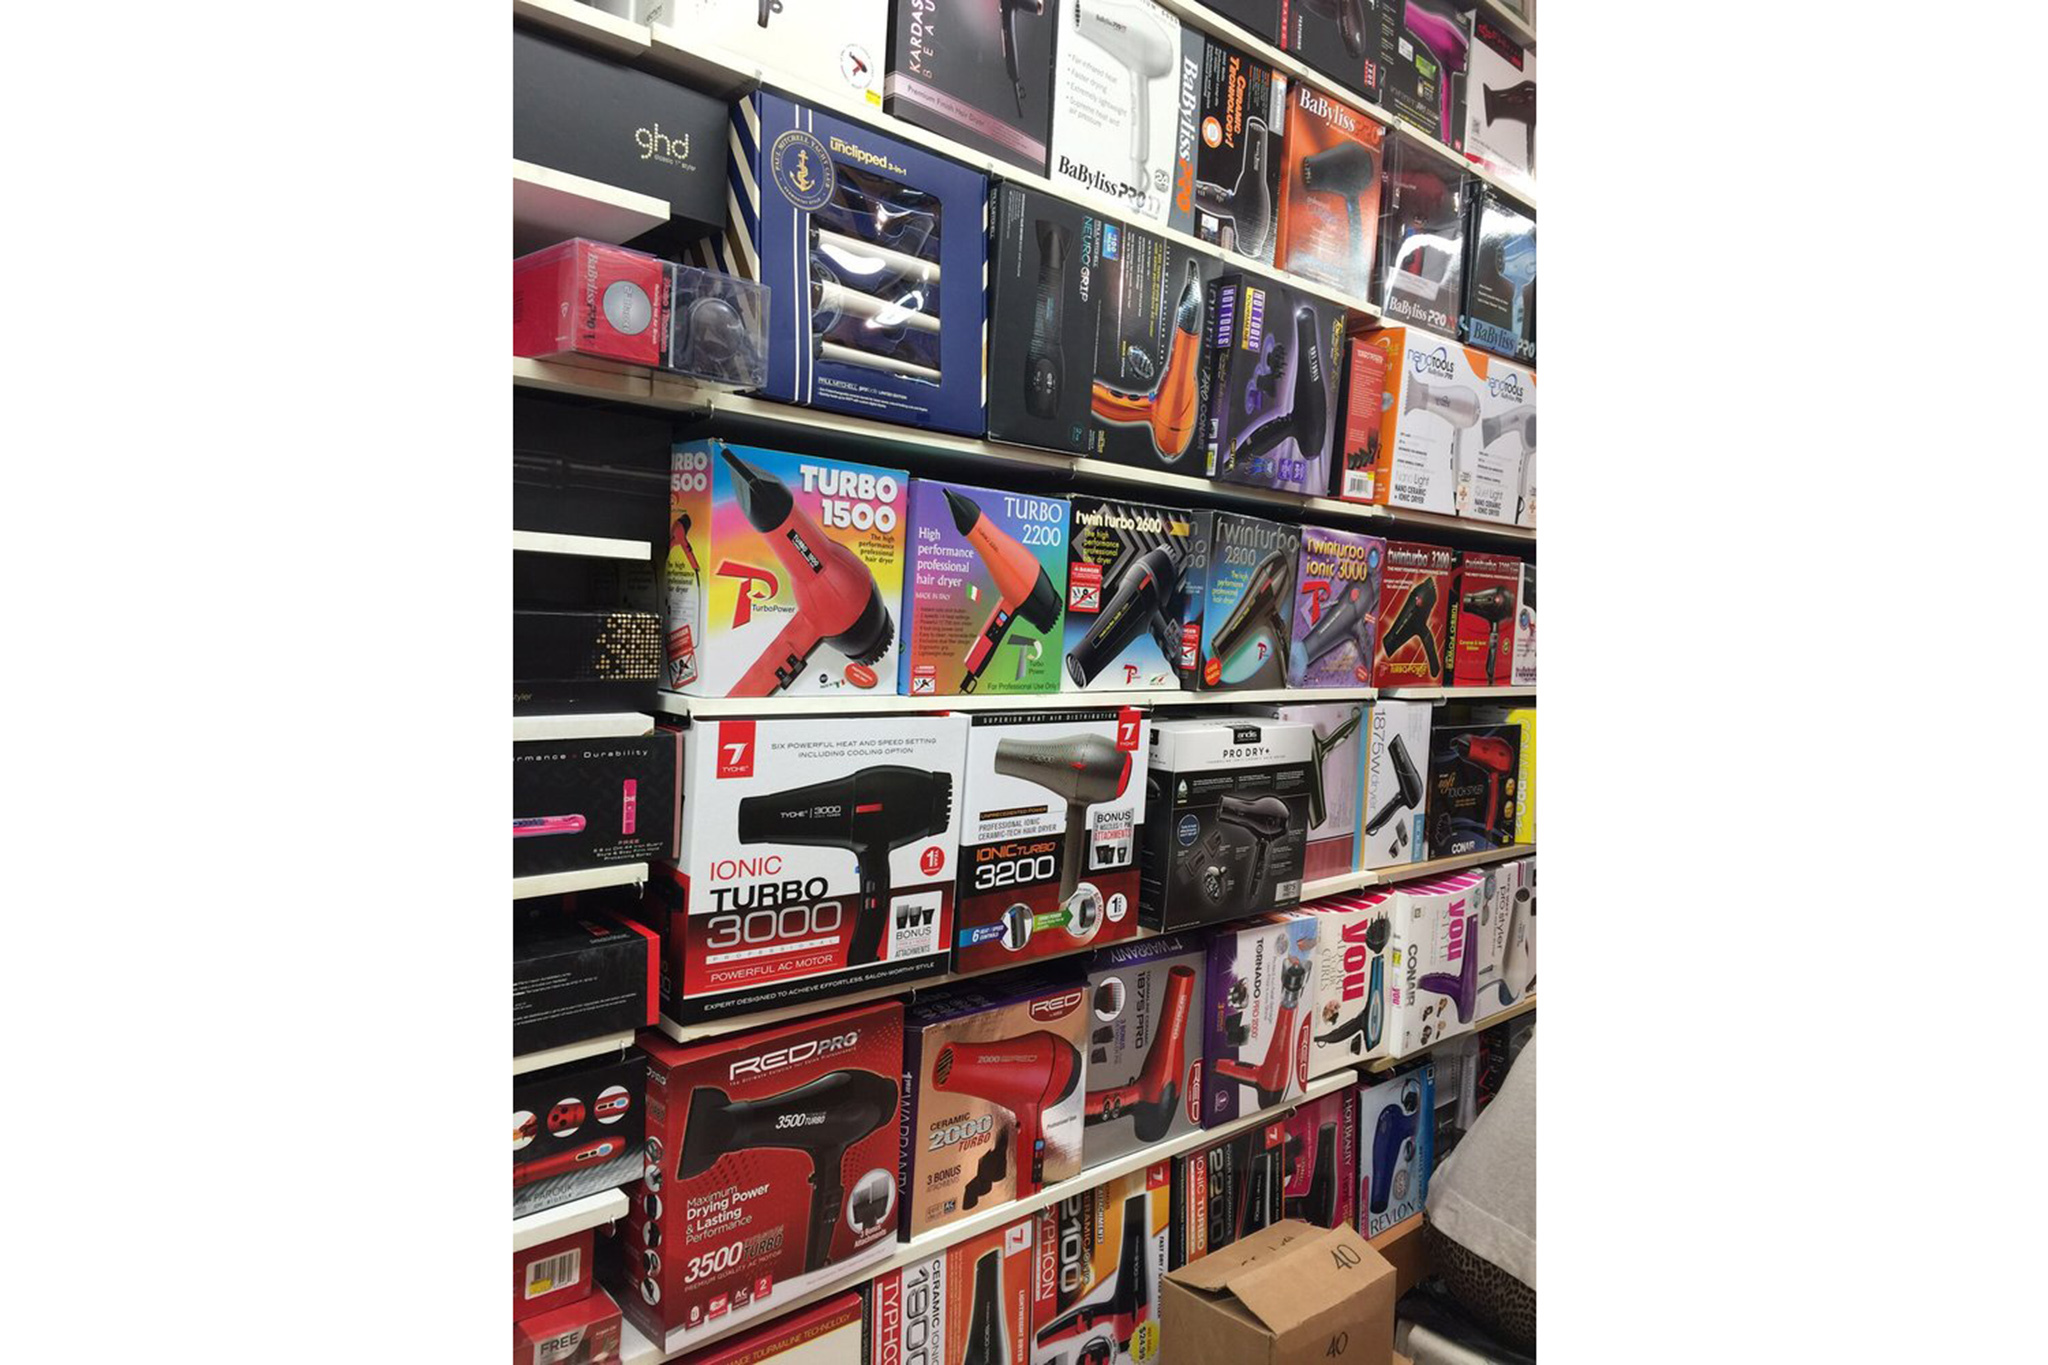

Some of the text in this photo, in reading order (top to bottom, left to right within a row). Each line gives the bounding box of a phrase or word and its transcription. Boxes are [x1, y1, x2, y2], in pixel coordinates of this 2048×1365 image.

[1234, 75, 1246, 134] CERAMIC
[635, 123, 689, 160] ghd
[830, 138, 887, 168] unclipped
[1390, 296, 1427, 320] BaByliss
[1474, 321, 1514, 350] BaByliss
[800, 463, 898, 504] TURBO
[1414, 474, 1429, 488] Light
[822, 498, 897, 533] 1500
[1004, 496, 1063, 524] TURBO
[1076, 510, 1162, 533] twin turbo 2600
[858, 540, 894, 551] performance
[881, 535, 895, 543] high
[918, 527, 941, 541] High
[1022, 524, 1061, 547] 2200
[1084, 538, 1119, 548] performance
[1097, 531, 1109, 540] high
[860, 548, 894, 558] professional
[865, 555, 894, 565] hair dryer
[918, 544, 974, 558] performance
[1224, 546, 1256, 566] 2800
[917, 559, 970, 573] professional
[1305, 555, 1368, 582] ionic 3000
[916, 574, 962, 588] hair dryer
[998, 682, 1031, 690] Professional
[787, 741, 834, 749] POWERFUL
[836, 740, 857, 748] HEAT
[906, 738, 937, 746] SETTING
[1237, 732, 1257, 740] andis
[583, 749, 649, 759] Durability
[798, 747, 914, 758] INCLUDING COOLING OPTION
[1223, 749, 1242, 759] PRO
[814, 805, 841, 815] 3000
[1097, 811, 1131, 822] BONUS
[978, 828, 1021, 841] CERAMIC-TECH
[1038, 824, 1057, 832] DRYER
[979, 820, 1022, 831] PROFESSIONAL
[975, 844, 1018, 862] IONIC
[1452, 841, 1475, 854] CONAIR
[710, 855, 782, 882] IONIC
[975, 855, 1055, 890] 3200
[709, 877, 829, 912] TURBO
[706, 901, 842, 949] 3000
[896, 927, 932, 940] BONUS
[972, 929, 979, 943] 6
[710, 954, 833, 984] POWERFUL AC MOTOR
[1253, 938, 1264, 999] TORNADO
[1406, 943, 1418, 1007] CONAIR
[703, 1000, 736, 1011] EXPERT
[736, 992, 776, 1005] DESIGNED
[777, 990, 787, 998] TO
[788, 986, 818, 997] ACHIEVE
[915, 961, 935, 971] STYLE
[1031, 990, 1083, 1015] RED
[1135, 971, 1146, 1049] 1875 PRO
[729, 1040, 818, 1080] RED
[775, 1113, 806, 1129] 3500
[928, 1114, 993, 1152] 2000
[929, 1112, 970, 1131] CERAMIC
[959, 1132, 991, 1152] TURBO
[927, 1164, 961, 1185] 3 BONUS
[687, 1184, 738, 1209] Maximum
[687, 1184, 770, 1221] Drying Power
[1196, 1156, 1205, 1250] IONIC TURBO
[1209, 1148, 1225, 1244] 2200
[686, 1207, 742, 1235] & Lasting
[686, 1214, 752, 1246] Performance
[1370, 1201, 1415, 1235] REVLON
[743, 1233, 784, 1262] TURBO
[1330, 1244, 1362, 1272] 40
[684, 1241, 744, 1284] 3500
[685, 1277, 716, 1292] PREMIUM
[717, 1264, 746, 1279] QUALITY
[760, 1278, 767, 1291] 2
[735, 1287, 748, 1299] AC
[931, 1259, 940, 1329] CERAMIC
[540, 1331, 580, 1356] FREE
[1325, 1331, 1349, 1359] 40
